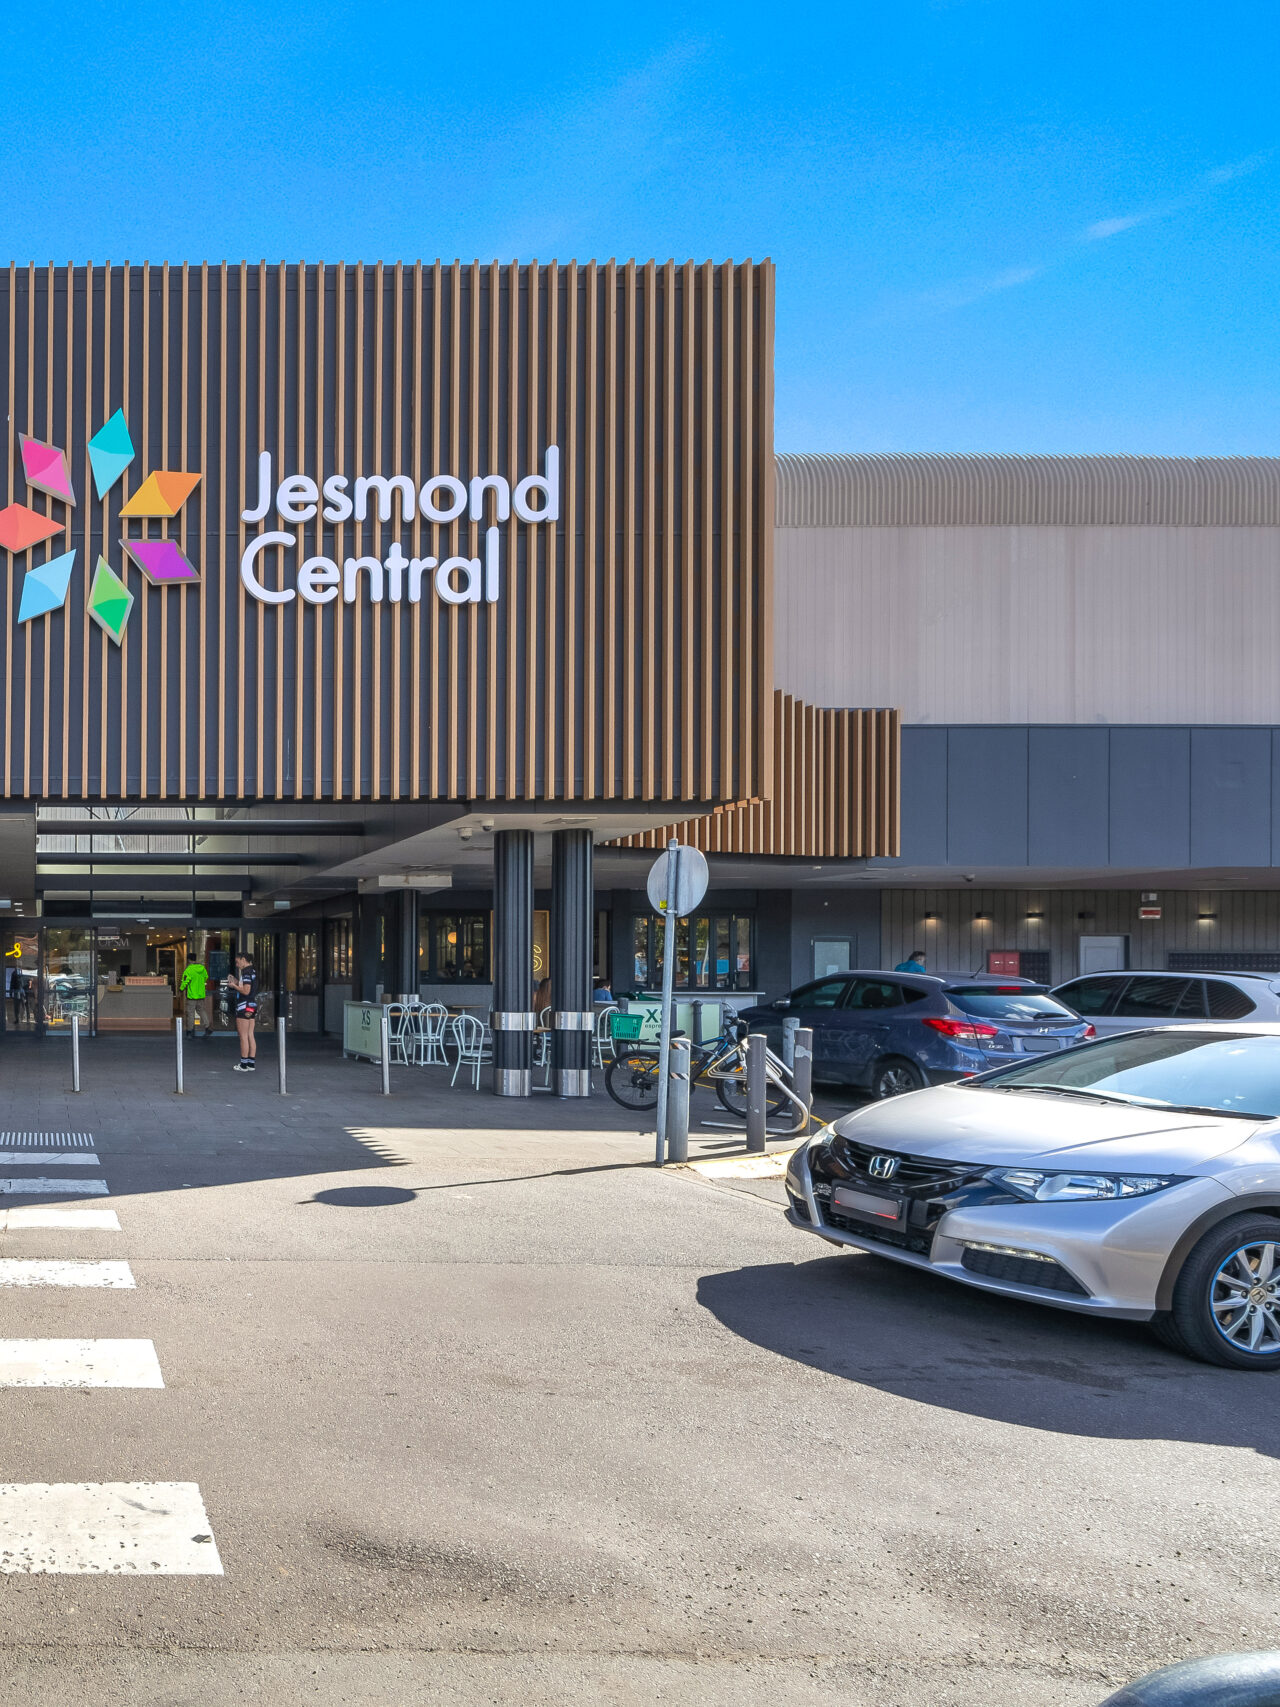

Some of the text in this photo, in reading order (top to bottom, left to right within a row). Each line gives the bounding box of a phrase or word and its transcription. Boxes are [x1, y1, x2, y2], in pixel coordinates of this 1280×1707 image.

[241, 444, 560, 525] Jesmond
[241, 526, 500, 605] Central
[361, 1009, 371, 1026] XS
[645, 1008, 663, 1023] X
